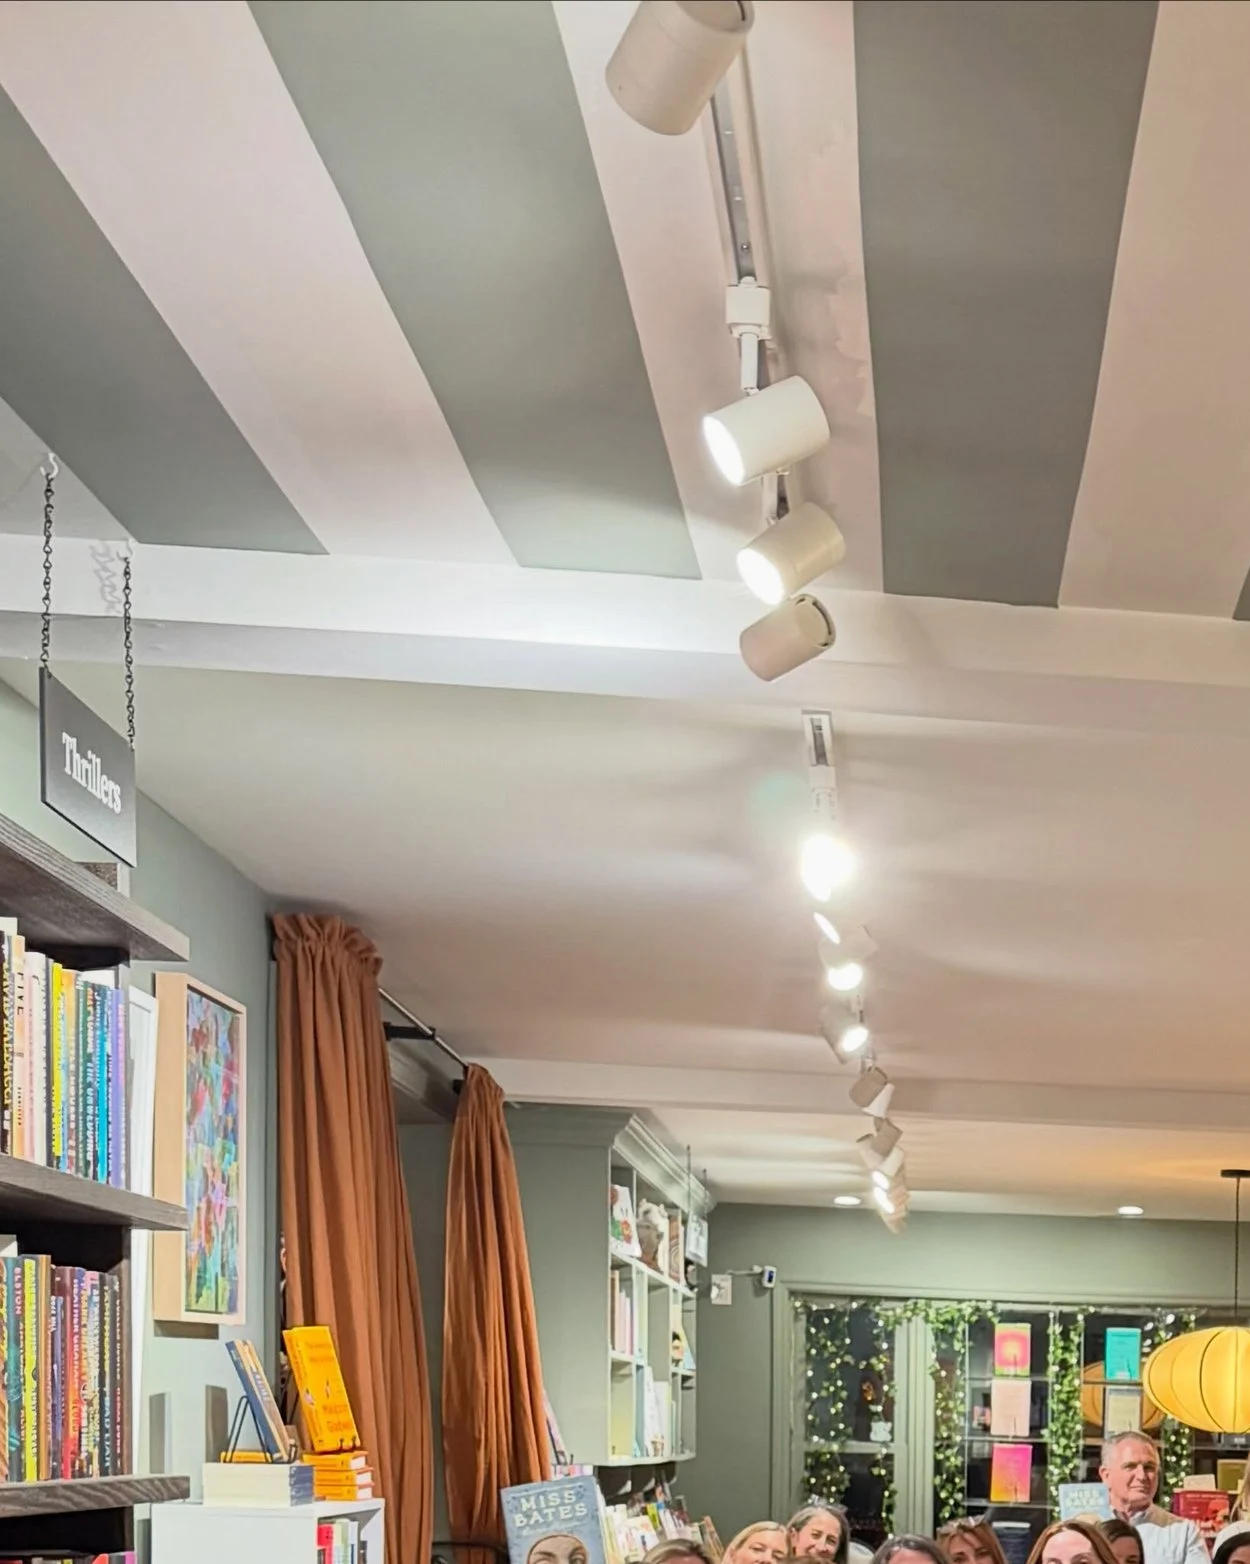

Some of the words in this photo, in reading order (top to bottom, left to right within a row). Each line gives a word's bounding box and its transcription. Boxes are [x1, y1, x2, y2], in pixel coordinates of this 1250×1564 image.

[62, 731, 122, 814] Thrillers
[521, 1489, 577, 1512] MISS
[514, 1502, 588, 1528] BATES
